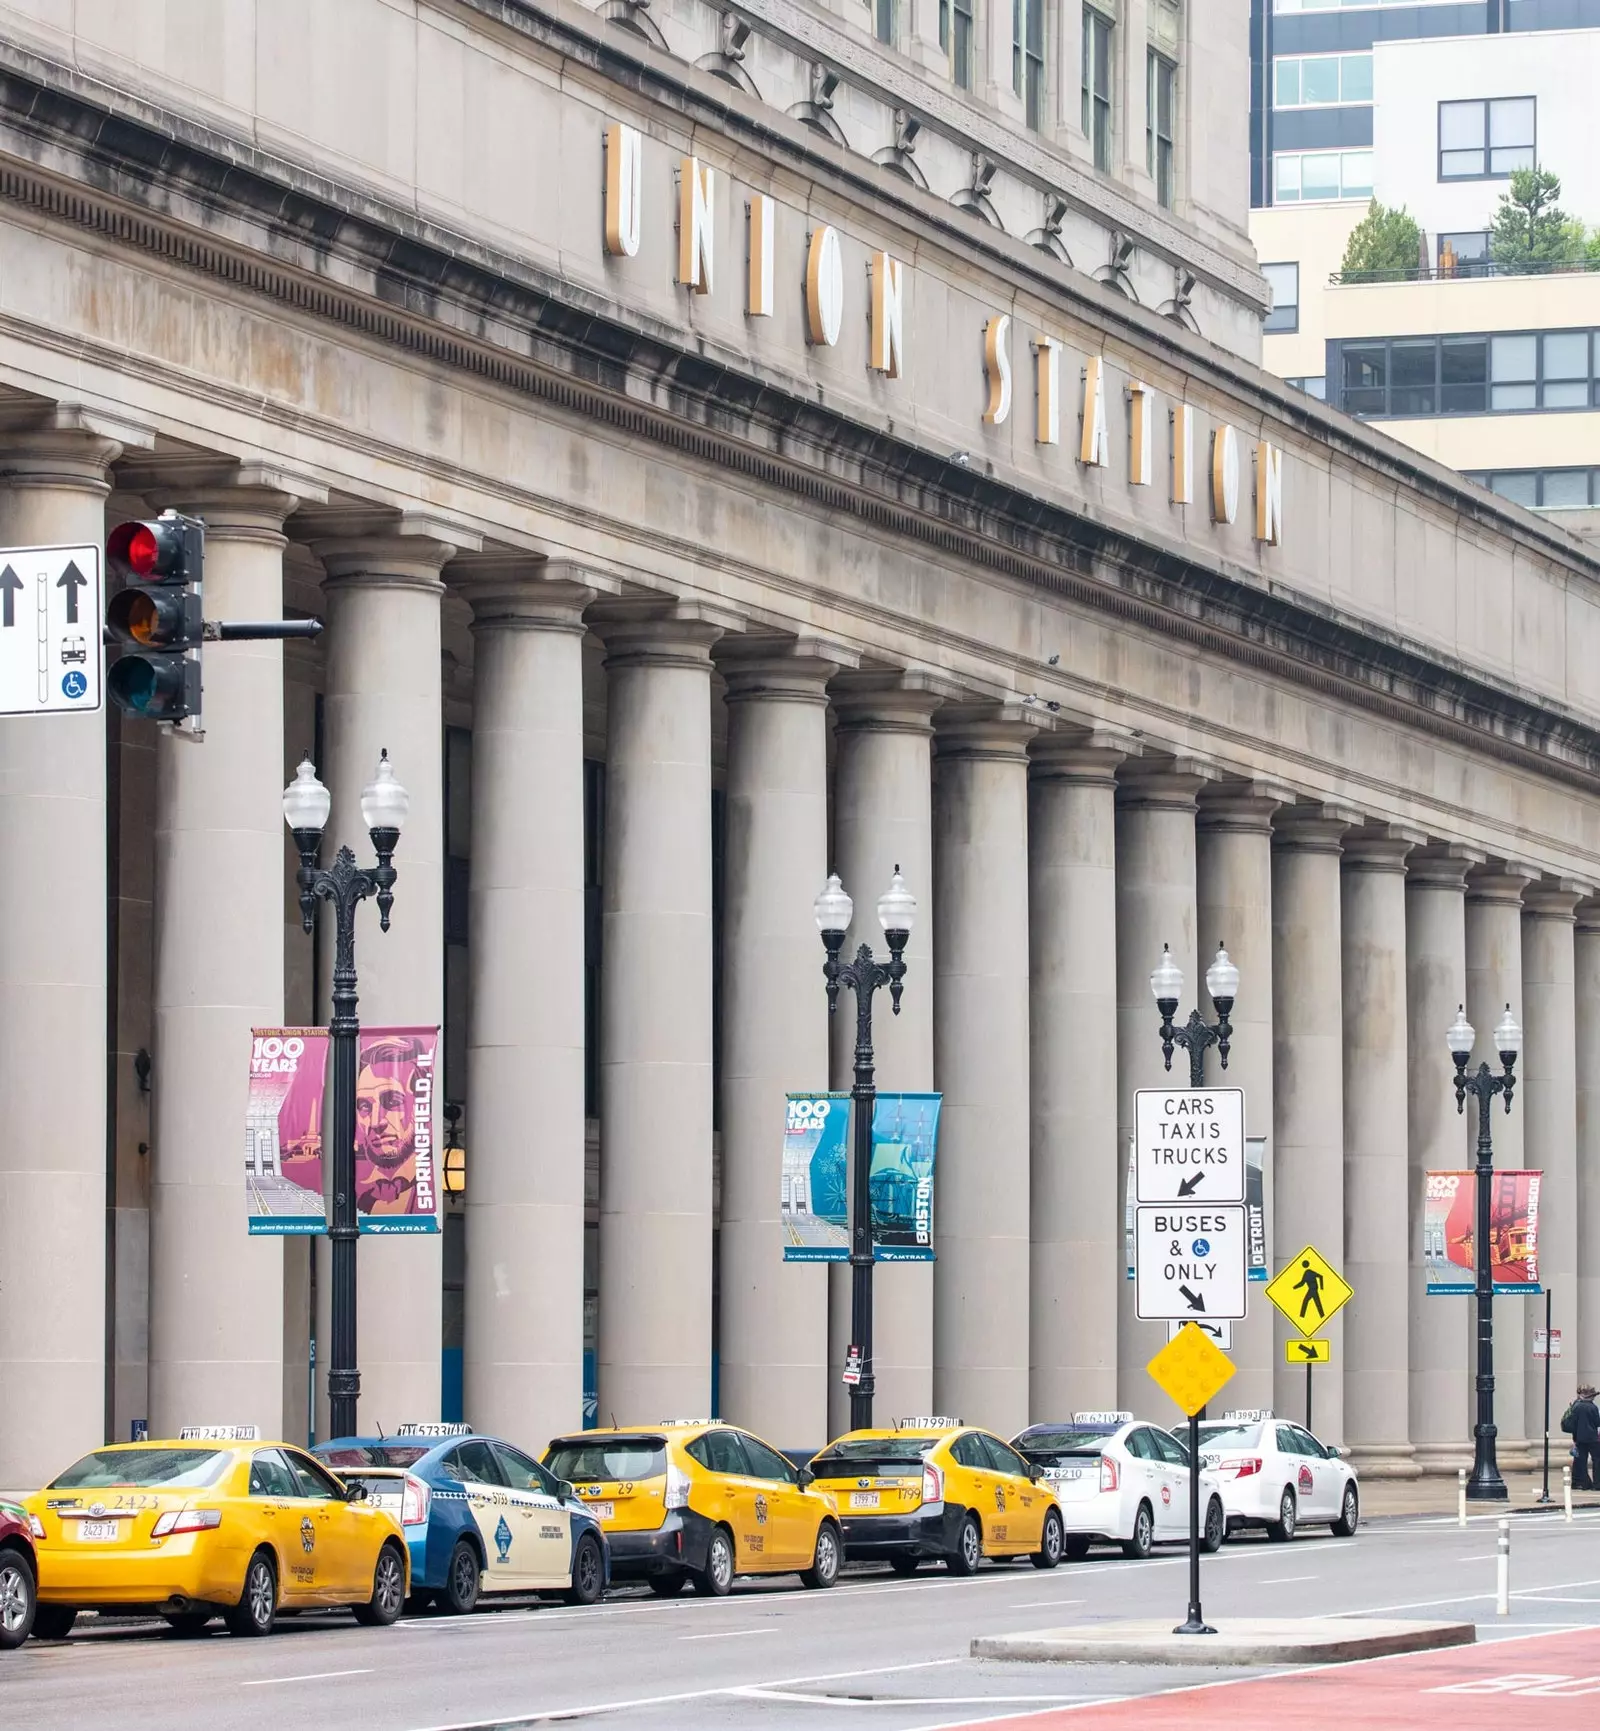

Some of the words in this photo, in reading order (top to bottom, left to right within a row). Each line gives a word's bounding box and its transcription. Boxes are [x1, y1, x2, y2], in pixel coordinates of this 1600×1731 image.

[606, 123, 903, 380] UNION
[982, 314, 1283, 547] STATION
[282, 1029, 302, 1037] UNION
[253, 1036, 305, 1059] 100
[251, 1058, 298, 1072] YEARS
[417, 1049, 433, 1067] IL
[787, 1099, 831, 1118] 100
[1164, 1098, 1215, 1116] CARS
[787, 1117, 825, 1129] YEARS
[1159, 1122, 1221, 1139] TAXIS
[414, 1071, 434, 1210] SPRINGFIELD,
[1152, 1147, 1229, 1165] TRUCKS
[1426, 1175, 1460, 1189] 100
[915, 1177, 933, 1244] BOSTON
[1526, 1177, 1540, 1251] FRANCISCO
[1154, 1215, 1228, 1232] BUSES
[1249, 1204, 1264, 1265] DETROIT
[1169, 1240, 1183, 1256] &
[1164, 1263, 1218, 1280] ONLY
[1526, 1254, 1537, 1281] SAN
[918, 1417, 945, 1428] 1799
[1089, 1413, 1115, 1424] 6210
[1237, 1411, 1258, 1420] 3993
[183, 1427, 200, 1440] TAXI
[203, 1427, 234, 1440] 2423
[236, 1426, 255, 1440] TAXI
[419, 1425, 447, 1437] 5733
[1054, 1469, 1083, 1478] 6210
[617, 1482, 634, 1495] 29
[898, 1487, 921, 1500] 1799
[113, 1495, 160, 1509] 2423
[368, 1494, 383, 1507] 33
[83, 1525, 103, 1537] 2423
[106, 1524, 117, 1536] TX
